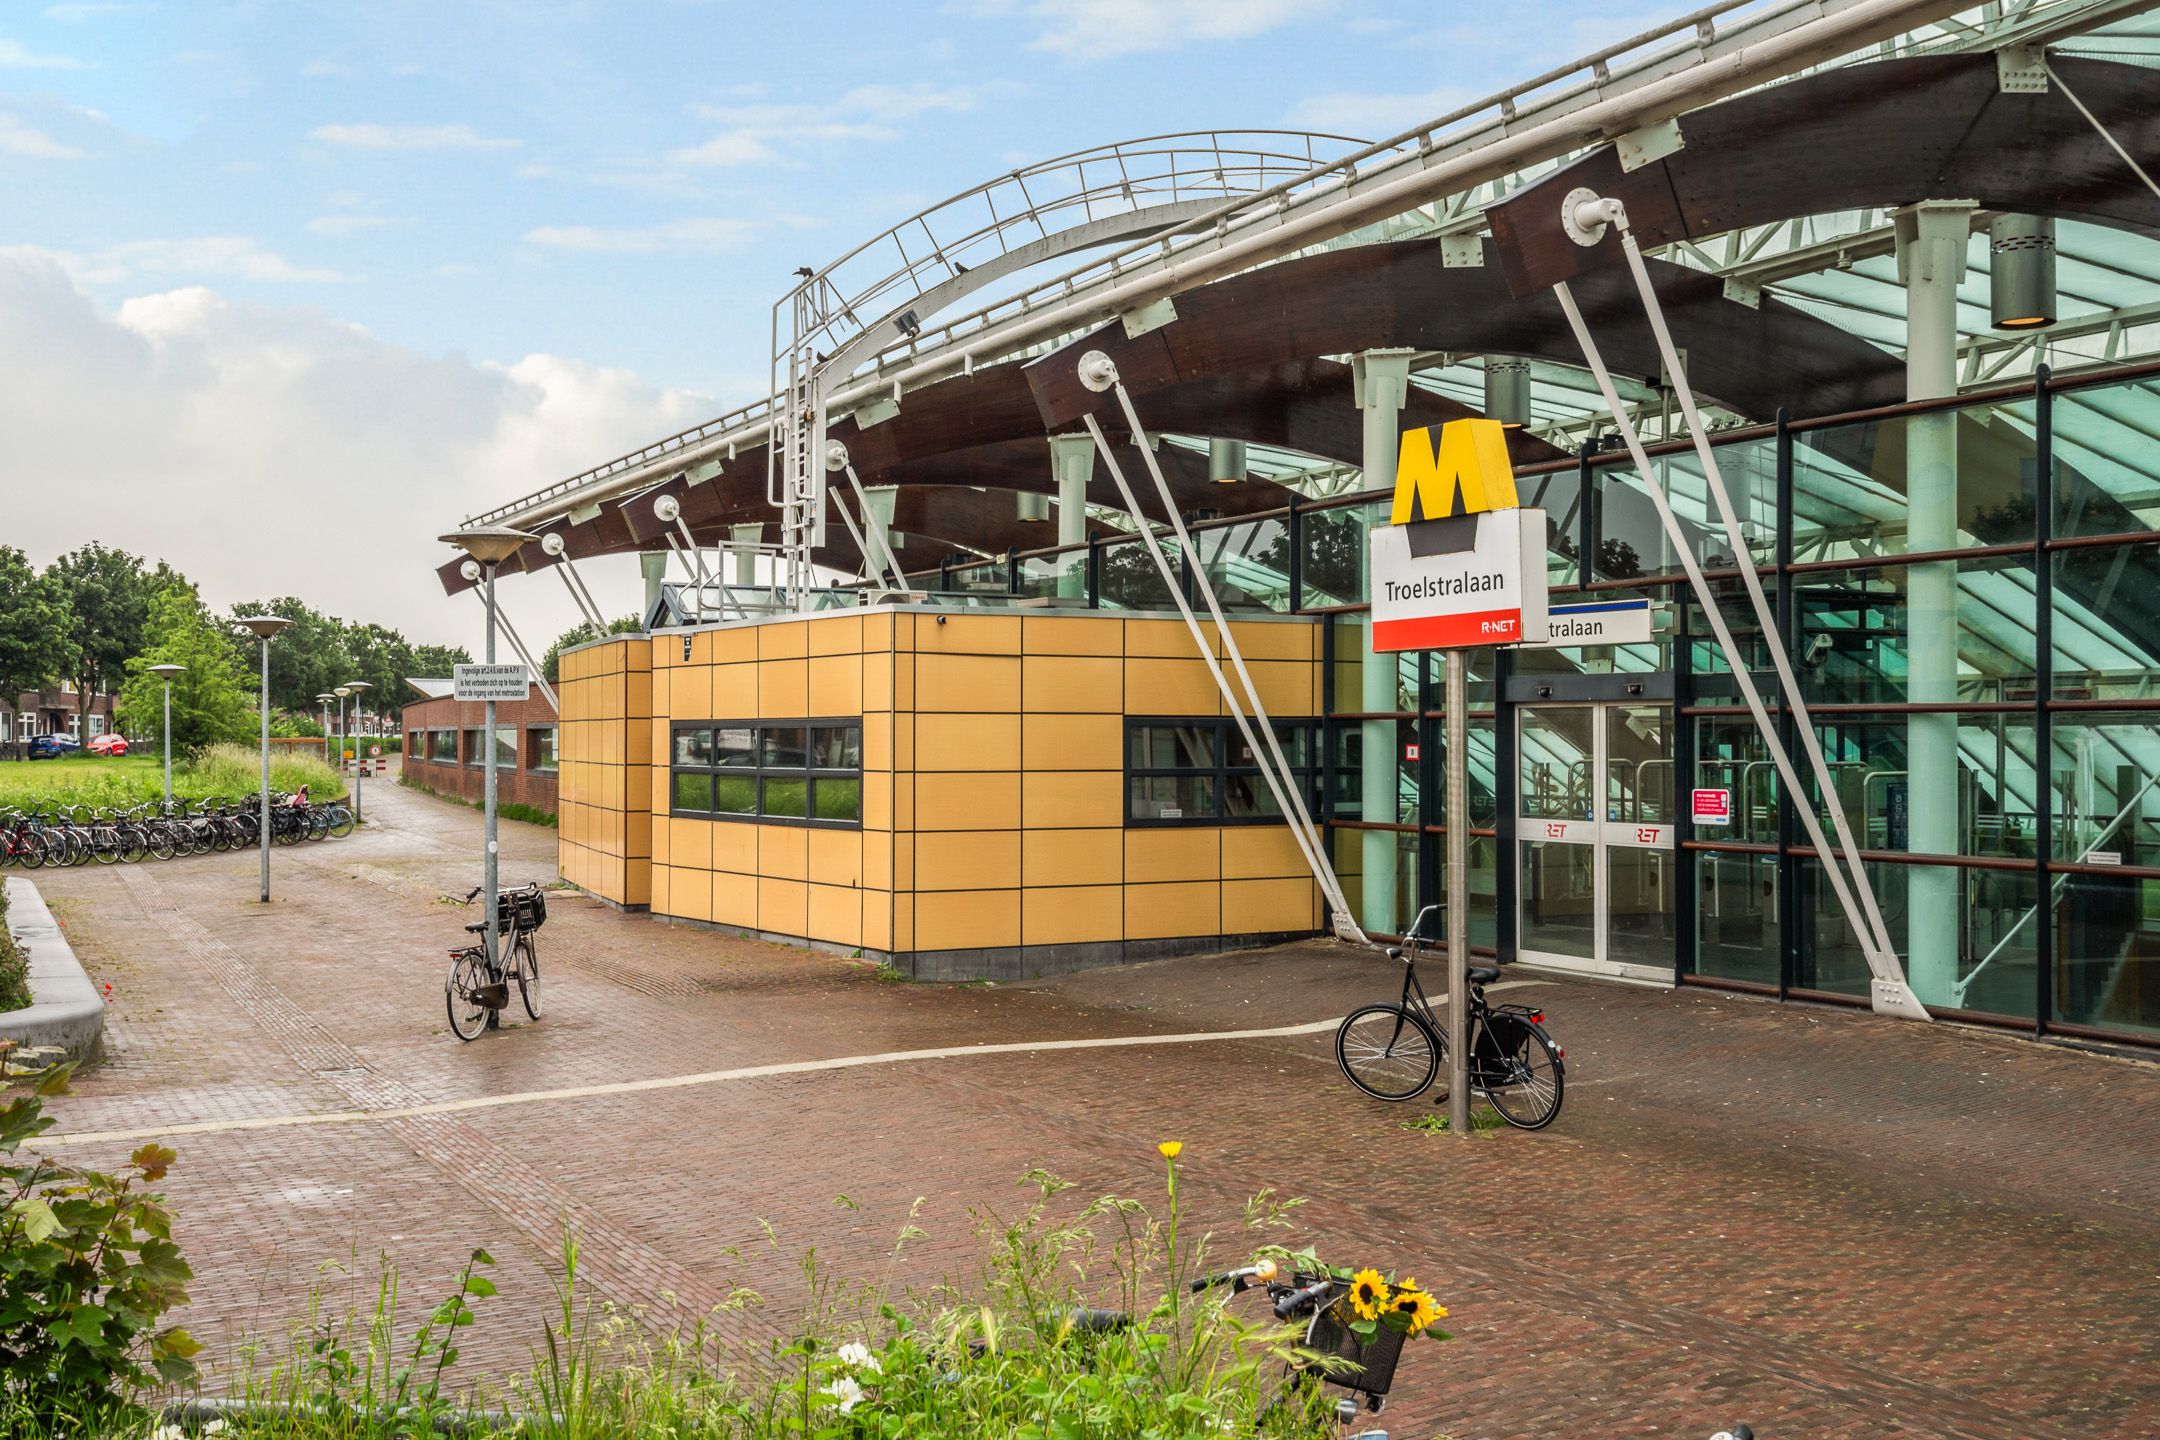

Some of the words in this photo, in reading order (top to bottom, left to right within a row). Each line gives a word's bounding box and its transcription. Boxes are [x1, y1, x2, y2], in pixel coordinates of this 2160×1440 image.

[1391, 418, 1489, 525] M
[1385, 570, 1504, 602] Troelstralaan
[1548, 618, 1603, 638] tralaan
[474, 690, 486, 698] ingang
[1545, 823, 1567, 838] RET
[1635, 828, 1660, 843] RET
